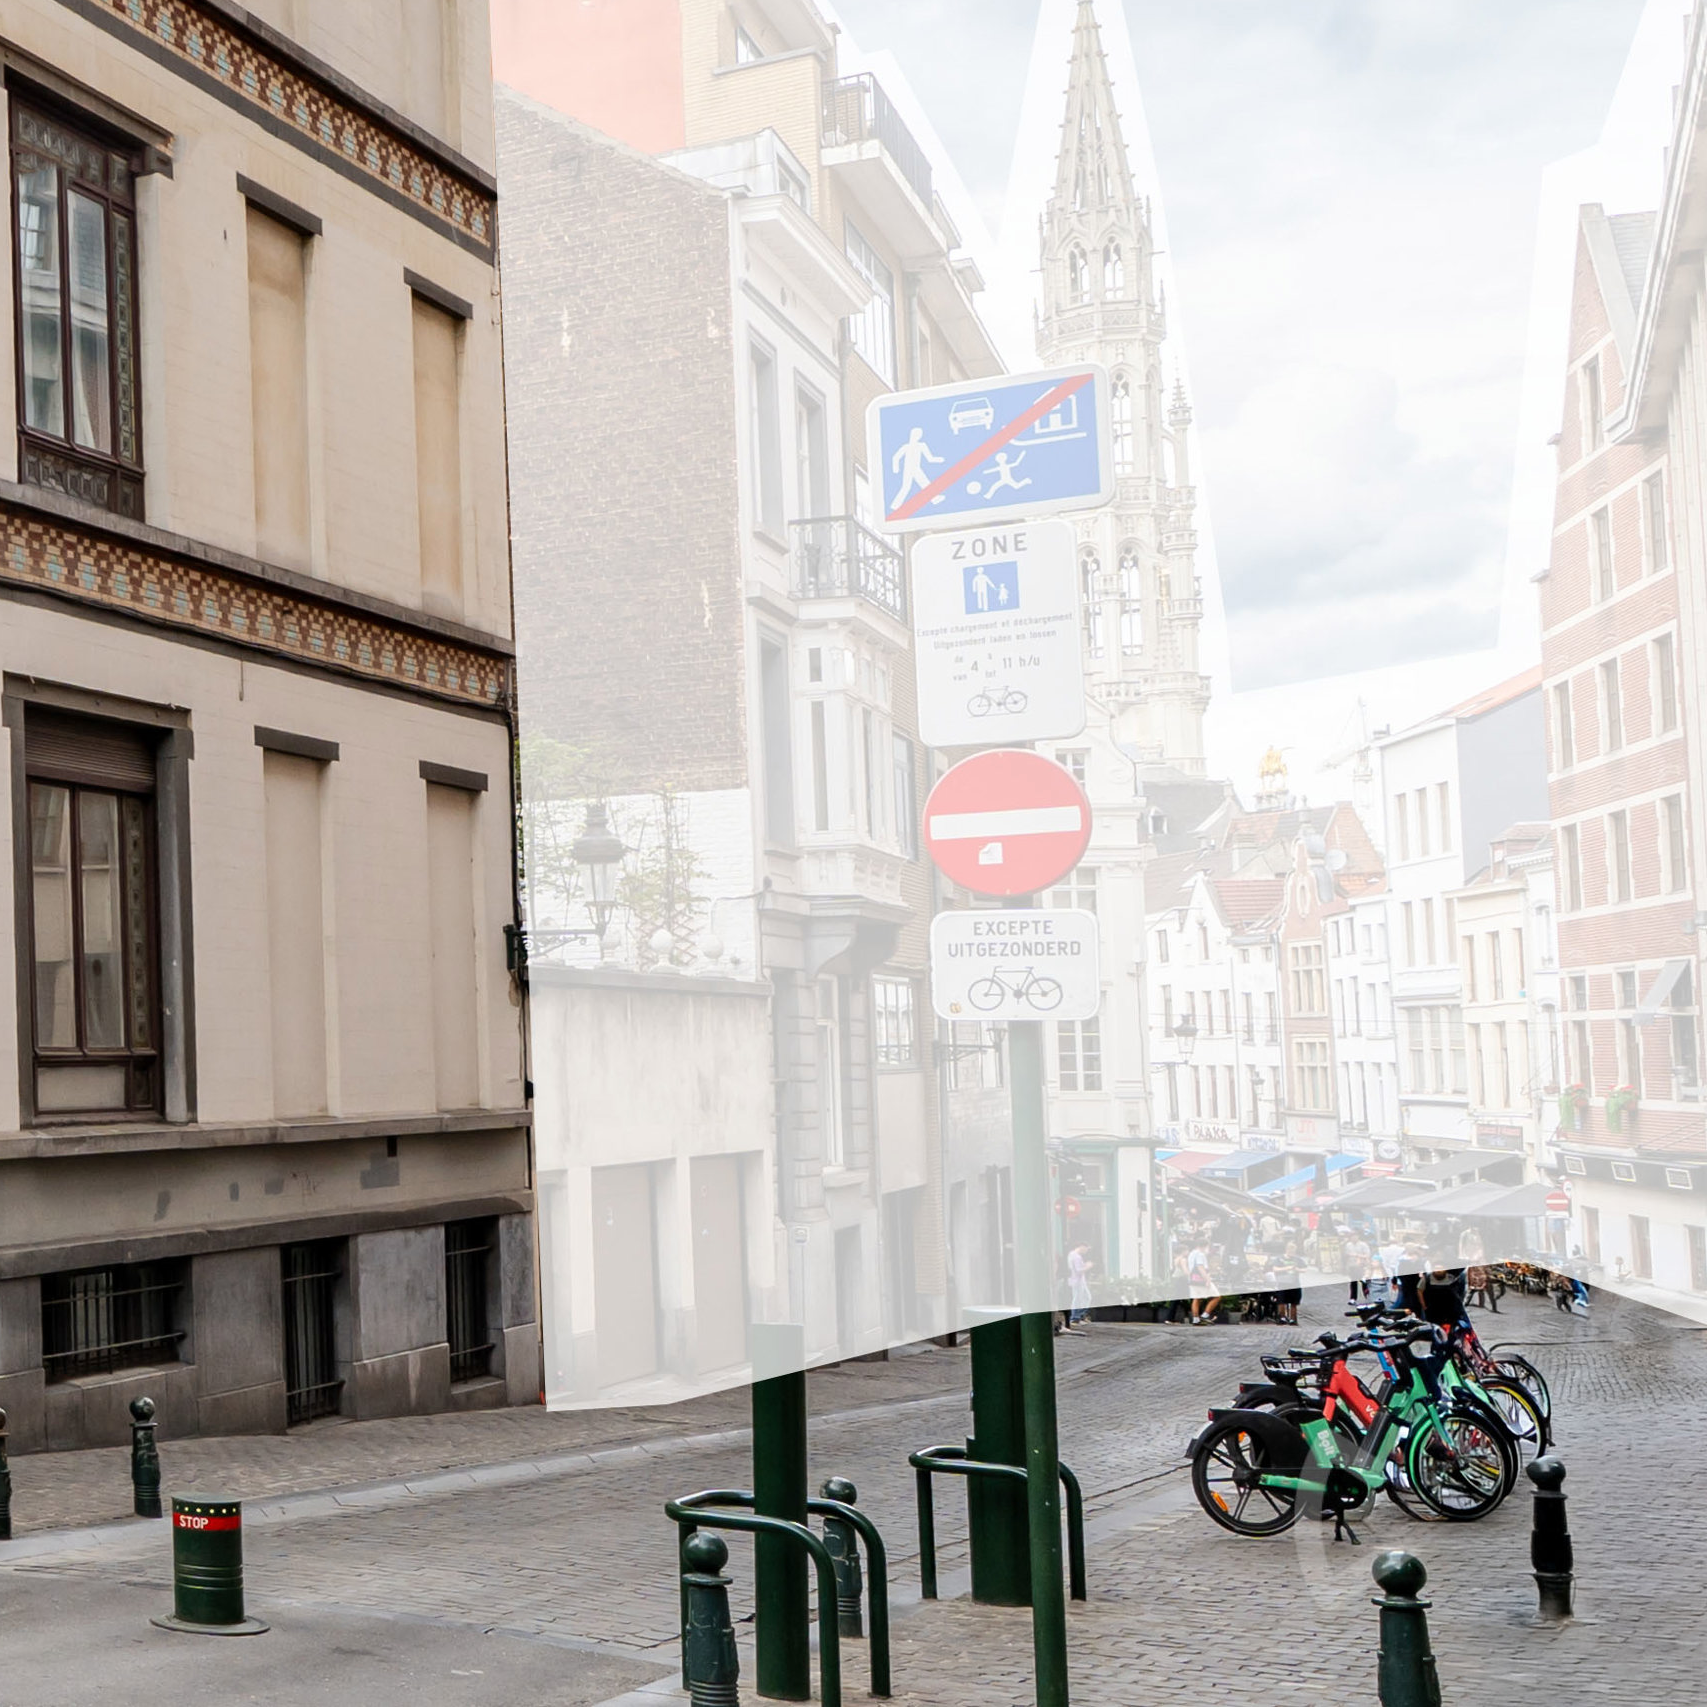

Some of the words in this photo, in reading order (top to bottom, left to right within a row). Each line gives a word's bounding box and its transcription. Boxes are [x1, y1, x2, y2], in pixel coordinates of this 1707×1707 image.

[951, 532, 1028, 560] ZONE
[971, 660, 978, 671] 4
[1003, 657, 1012, 669] 11
[973, 920, 1054, 936] EXCEPTE
[947, 941, 1081, 958] UITGEZONDERD
[1317, 1429, 1336, 1456] Bolt
[179, 1514, 209, 1530] STOP
